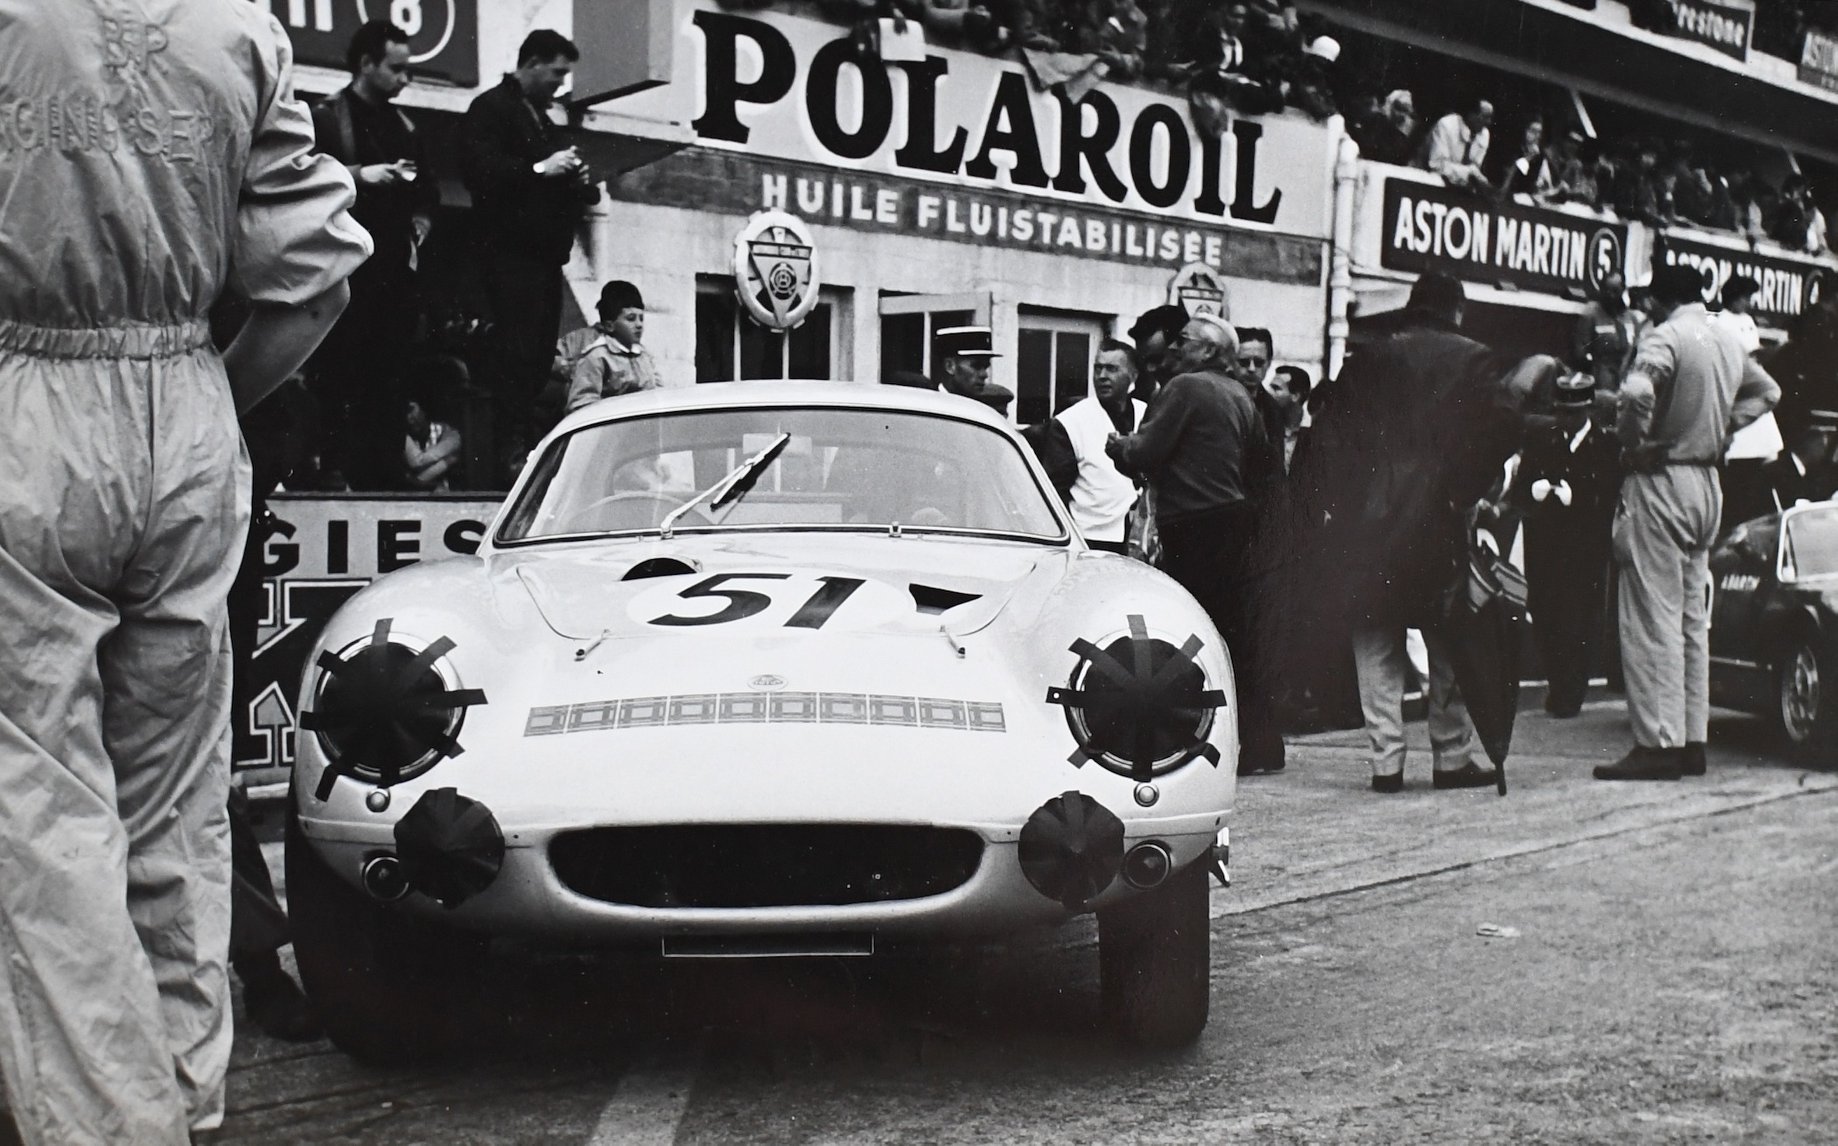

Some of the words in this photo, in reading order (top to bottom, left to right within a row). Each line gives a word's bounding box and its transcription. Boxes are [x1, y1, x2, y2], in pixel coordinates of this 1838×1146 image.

[692, 9, 1282, 225] POLAROIL
[762, 174, 898, 224] HUILE
[918, 196, 1222, 267] FLUISTABILISÉE
[1394, 197, 1490, 264] ASTON
[1495, 216, 1587, 280] MARTIN
[647, 573, 867, 629] 51
